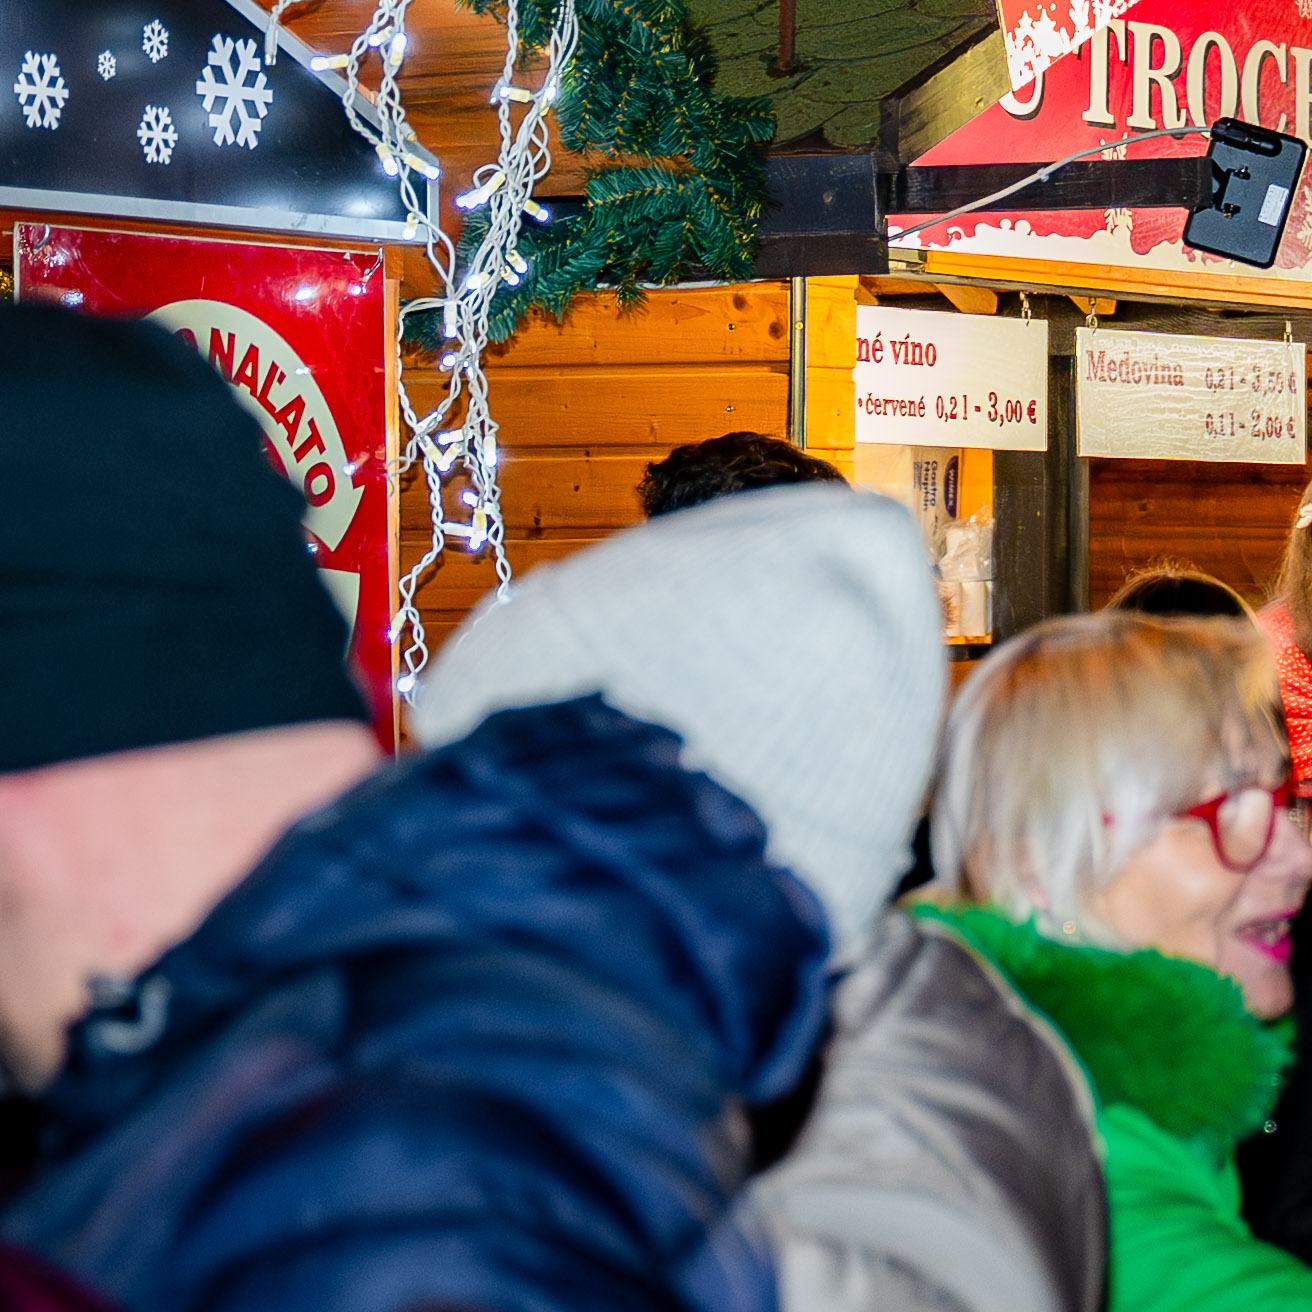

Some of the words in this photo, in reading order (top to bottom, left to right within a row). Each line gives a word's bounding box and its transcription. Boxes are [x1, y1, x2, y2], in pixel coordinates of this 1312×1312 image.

[890, 333, 936, 367] víno
[1086, 350, 1184, 386] Medovina
[865, 393, 926, 417] červené
[988, 392, 1022, 427] 3,00
[930, 460, 938, 506] Gastro
